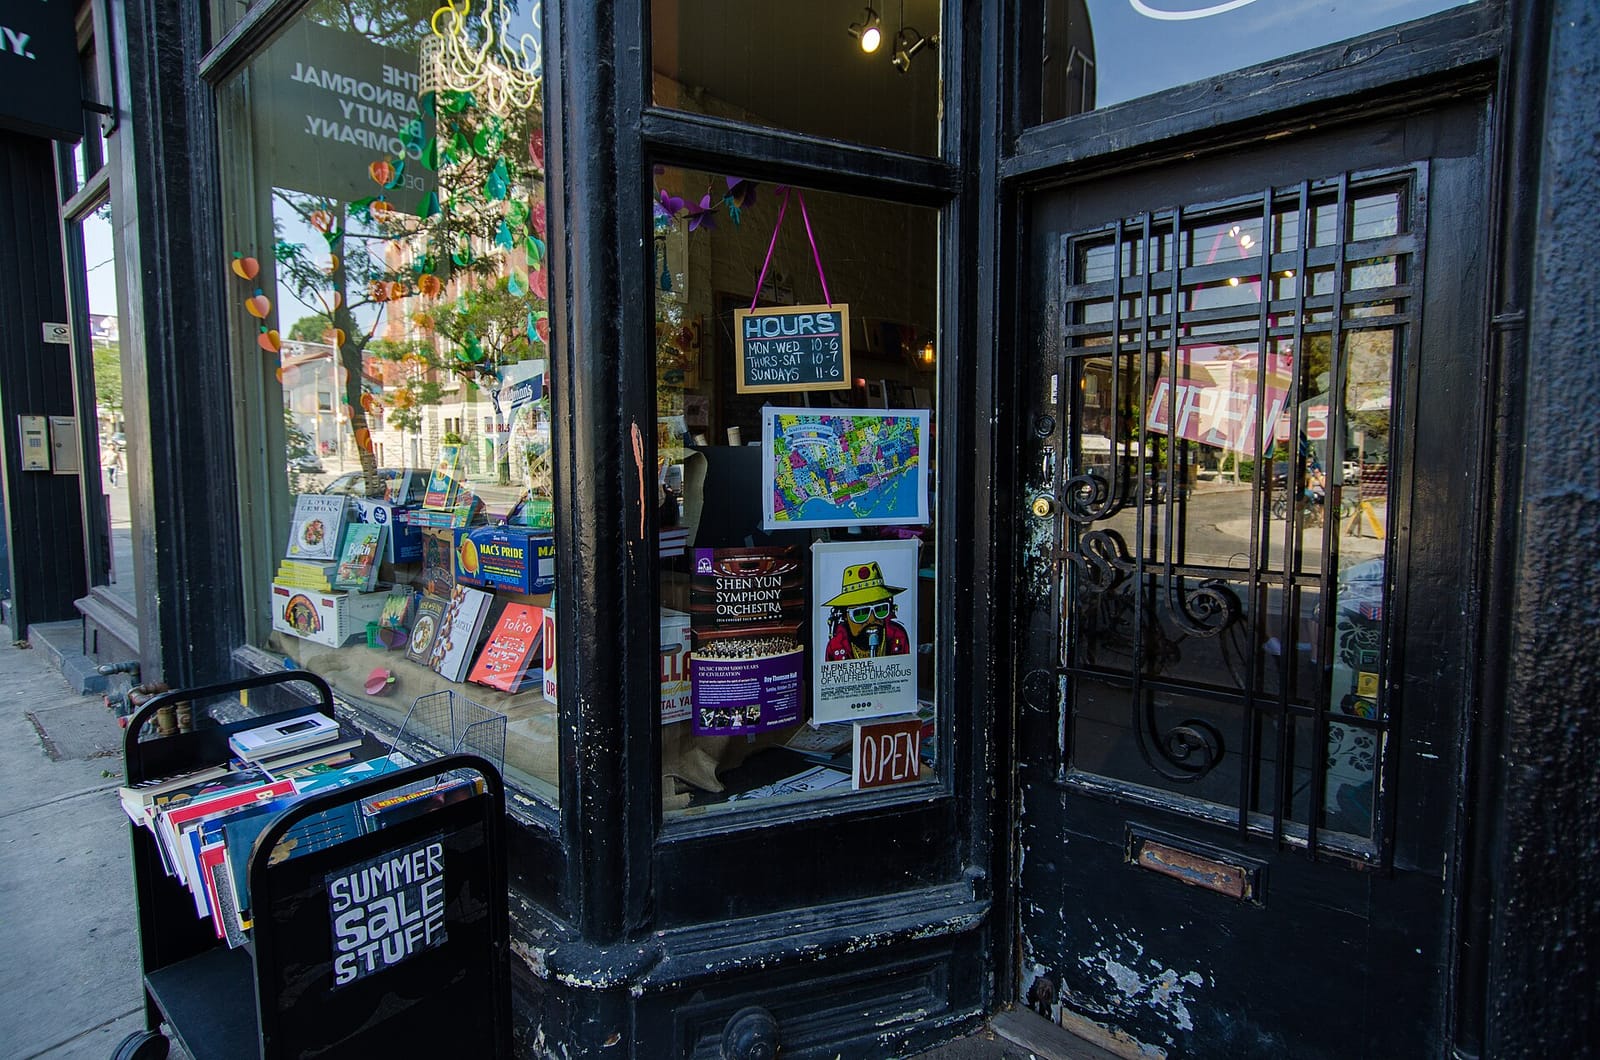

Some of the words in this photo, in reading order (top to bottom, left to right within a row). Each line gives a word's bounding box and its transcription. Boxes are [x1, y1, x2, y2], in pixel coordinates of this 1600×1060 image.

[746, 313, 835, 338] HOURS
[751, 367, 800, 382] SUNDAYS
[1150, 382, 1281, 450] OPEN
[480, 543, 499, 555] MAC'S
[501, 546, 524, 559] PRIDE
[716, 577, 751, 590] SHEN
[755, 576, 781, 588] YUN
[716, 589, 781, 603] SYMPHONY
[716, 602, 782, 616] ORCHESTRA
[821, 669, 837, 678] THE
[838, 665, 882, 676] DANCEHALL
[885, 663, 900, 671] ART
[831, 662, 847, 671] FINE
[821, 677, 833, 685] OF
[834, 674, 868, 683] WILFRED
[869, 668, 912, 680] LIMONIOUS
[546, 680, 555, 697] OR
[661, 700, 676, 710] TAL
[862, 730, 919, 783] OPEN
[331, 842, 443, 912] SUMMER
[335, 909, 444, 985] STUFF
